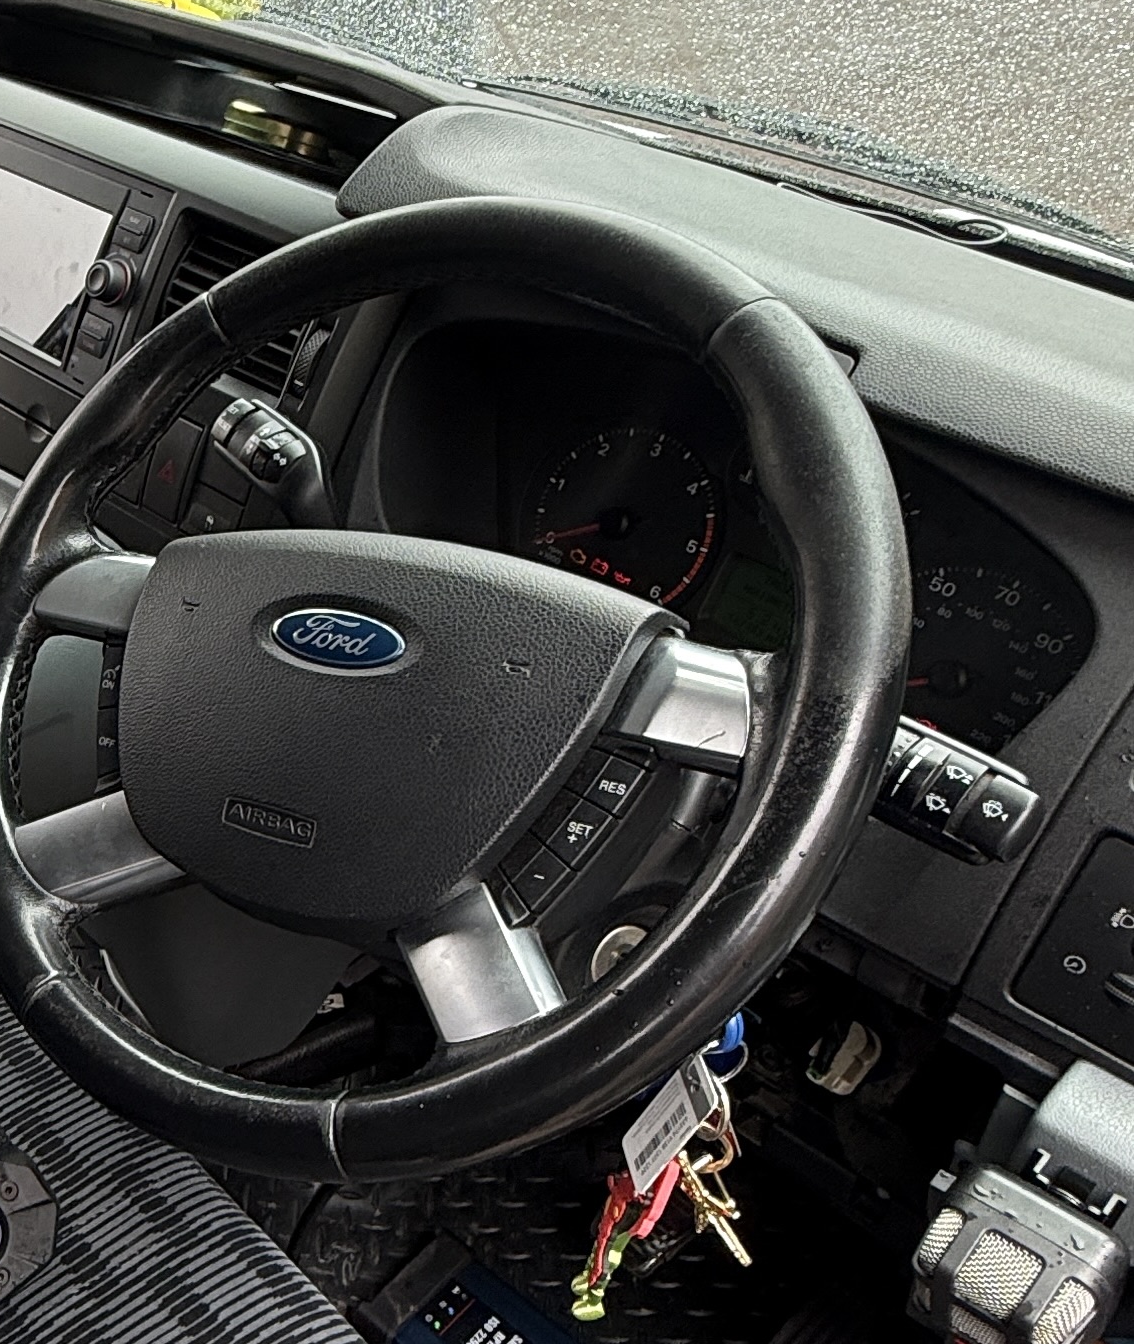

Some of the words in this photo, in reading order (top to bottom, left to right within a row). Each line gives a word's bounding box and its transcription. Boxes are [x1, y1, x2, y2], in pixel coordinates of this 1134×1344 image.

[596, 443, 611, 457] 2
[649, 443, 663, 458] 3
[686, 481, 700, 496] 4
[649, 585, 662, 599] 6
[928, 576, 957, 598] 50
[994, 585, 1021, 607] 70
[292, 614, 376, 656] Ford
[1033, 632, 1064, 655] 90
[101, 679, 116, 691] ON
[98, 735, 117, 748] OFF
[598, 779, 627, 796] RES
[227, 803, 313, 838] AIRBAG
[566, 821, 594, 839] SET
[483, 1316, 501, 1333] ISO
